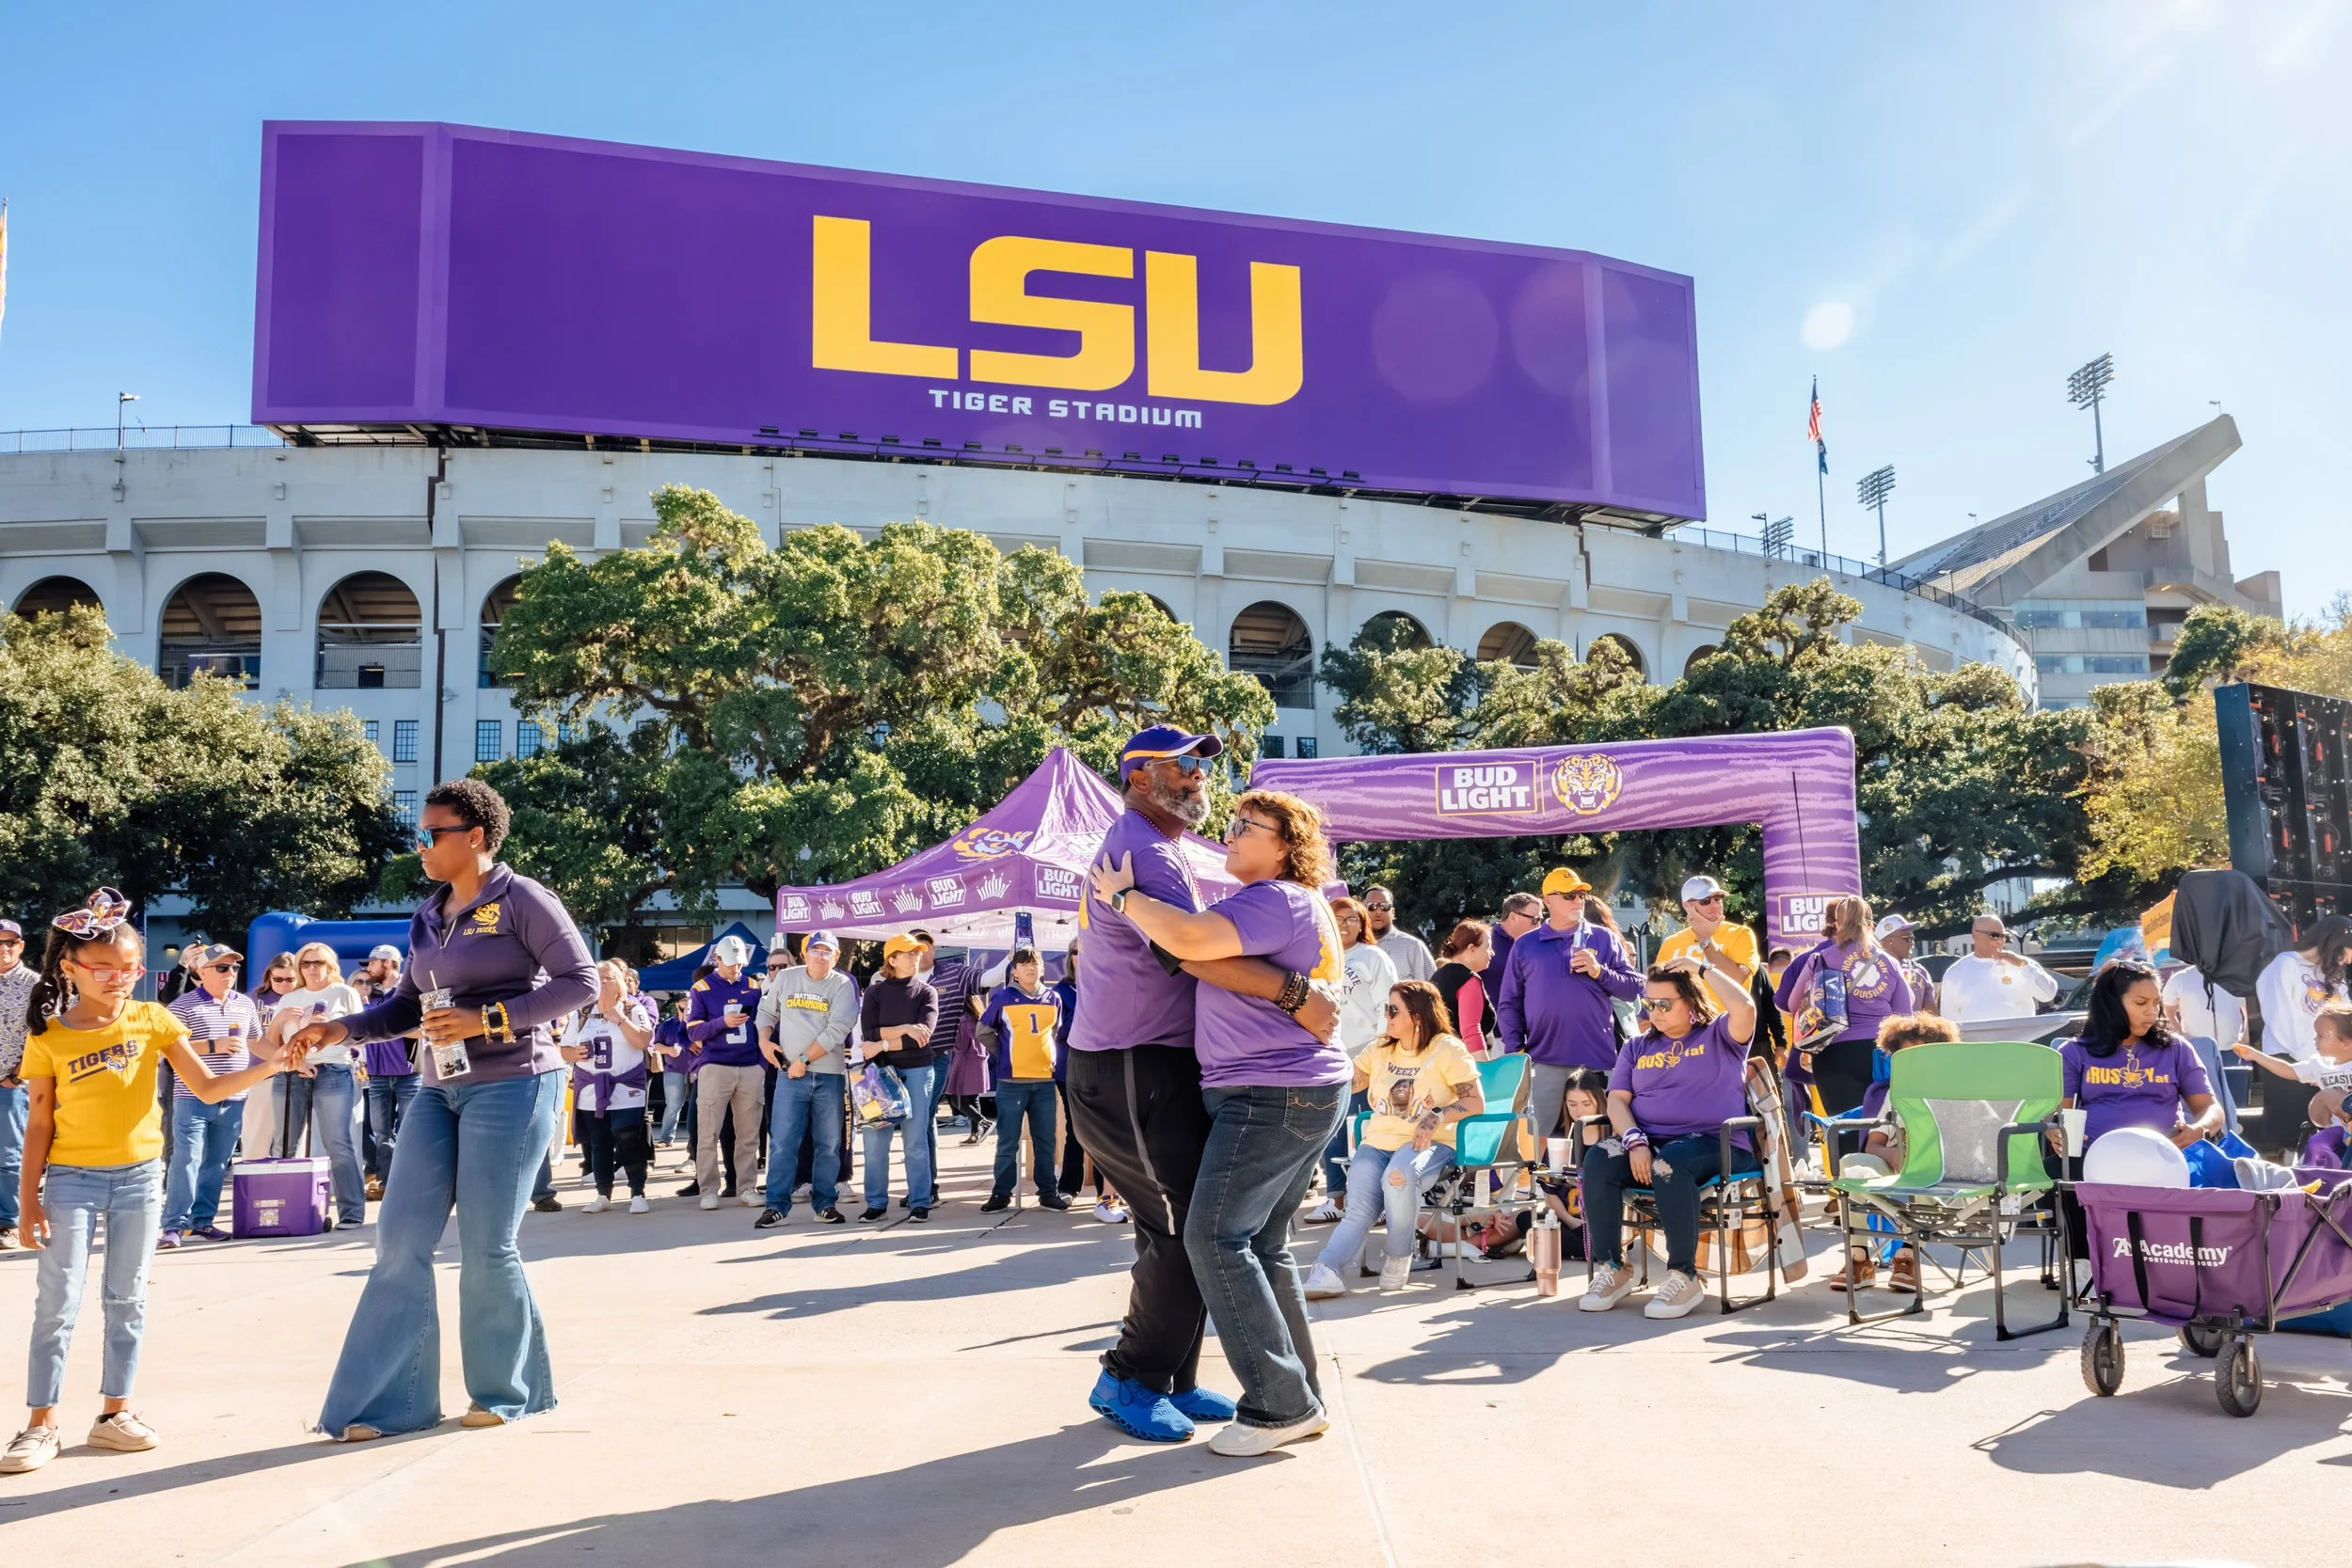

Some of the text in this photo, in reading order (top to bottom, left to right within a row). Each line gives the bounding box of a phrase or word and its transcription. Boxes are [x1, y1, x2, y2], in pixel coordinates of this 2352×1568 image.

[812, 214, 1304, 405] LSU
[929, 388, 1202, 429] TIGER STADIUM
[1454, 766, 1518, 788] BUD
[1043, 868, 1075, 884] BUD
[930, 878, 958, 894] BUD
[1038, 880, 1080, 898] LIGHT
[787, 896, 805, 908] BUD
[851, 891, 871, 903] BUD
[931, 889, 965, 906] LIGHT
[1789, 896, 1831, 915] BU
[783, 907, 810, 921] LIGHT
[851, 902, 882, 915] LIGHT
[1783, 913, 1827, 932] LIG
[1842, 951, 1860, 972] HOME
[1344, 965, 1362, 987] TATE
[786, 998, 829, 1013] CHAMPIONS
[1029, 1012, 1040, 1034] 1
[68, 1039, 138, 1075] TIGERS
[593, 1035, 612, 1069] 9
[1387, 1061, 1422, 1078] WEEZY
